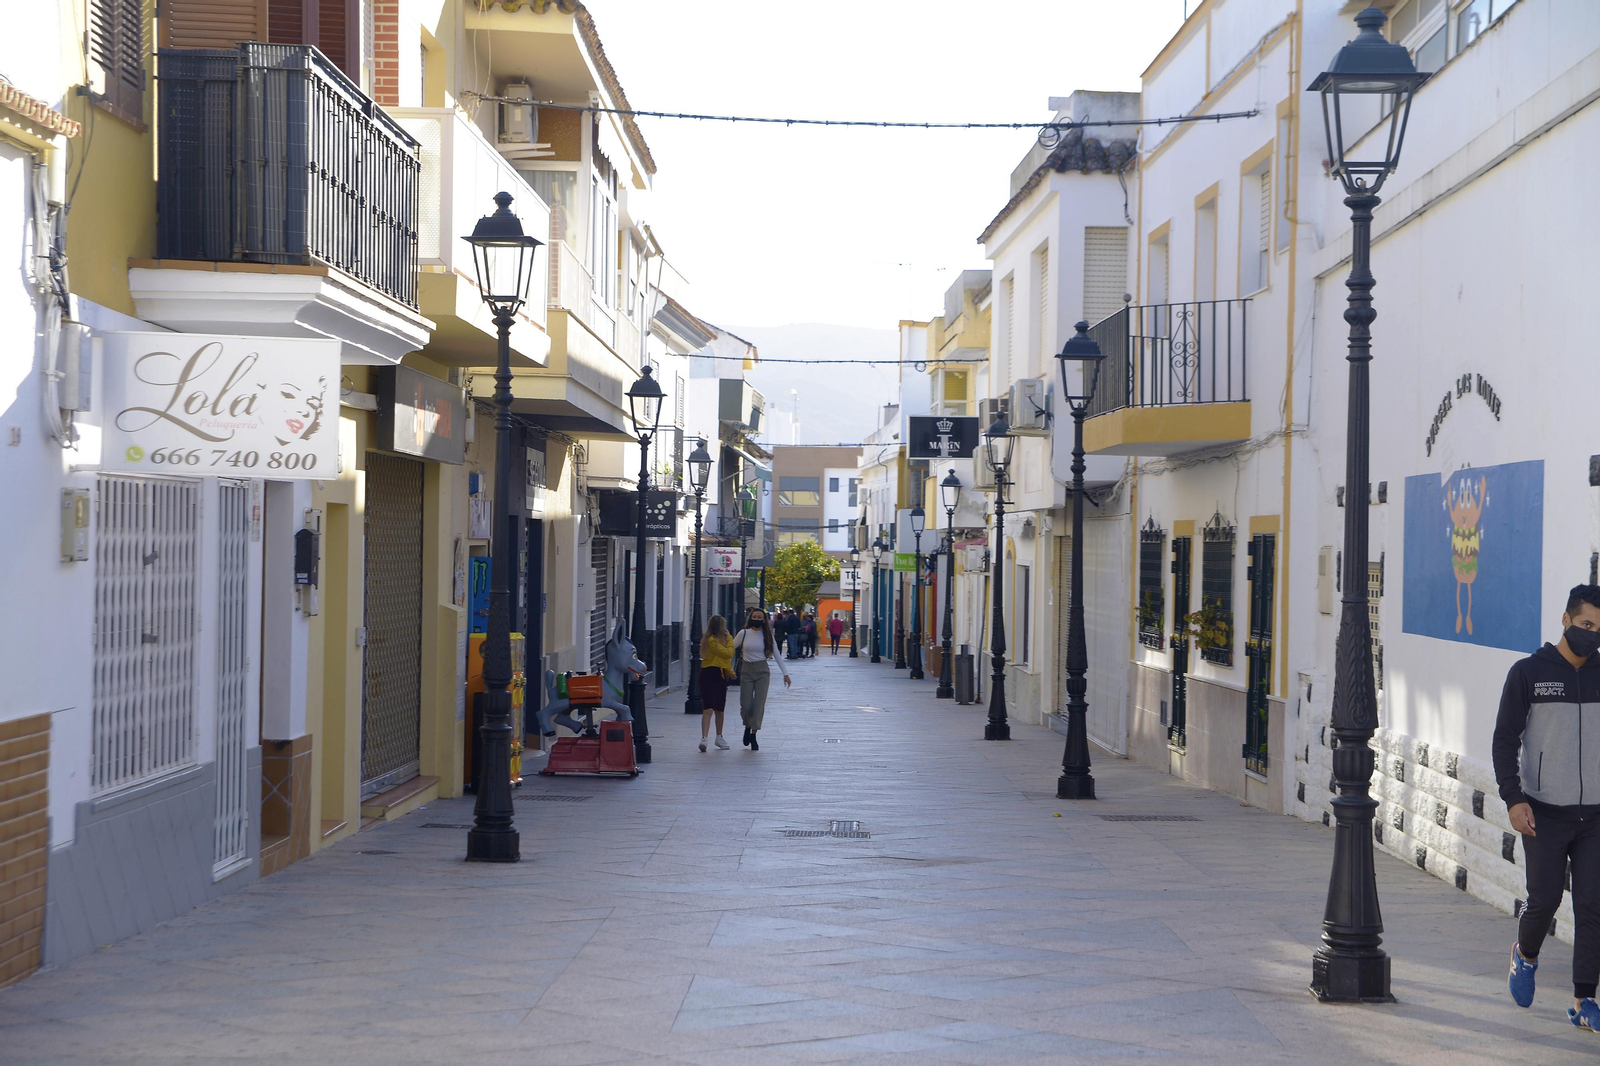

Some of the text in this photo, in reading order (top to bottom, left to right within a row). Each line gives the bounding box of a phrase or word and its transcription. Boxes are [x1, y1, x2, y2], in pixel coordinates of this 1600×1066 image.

[115, 341, 260, 443] Lola
[1456, 372, 1472, 399] LOS
[150, 447, 317, 470] 666 740 800
